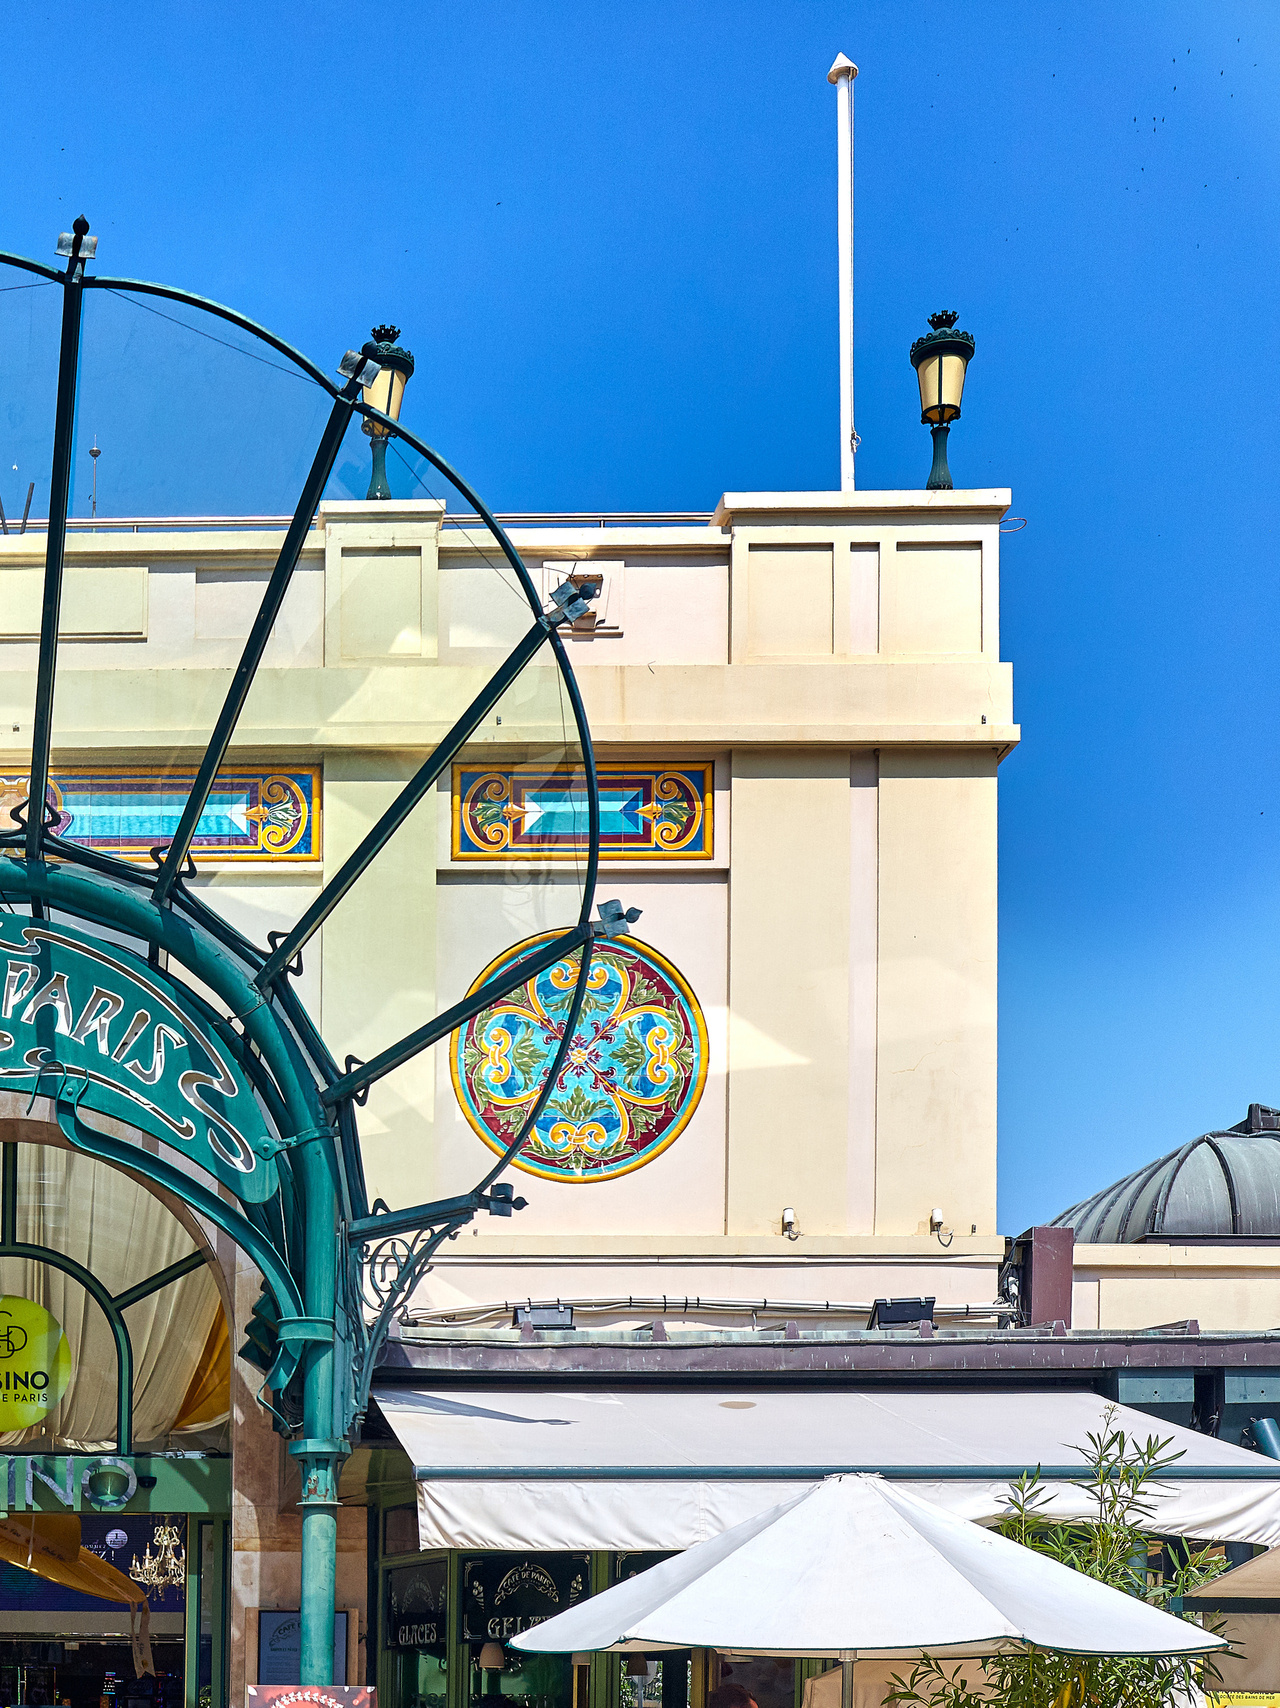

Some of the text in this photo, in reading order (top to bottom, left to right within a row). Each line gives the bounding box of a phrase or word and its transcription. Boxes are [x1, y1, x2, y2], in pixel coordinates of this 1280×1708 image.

[1, 960, 188, 1085] PARIS
[14, 1393, 48, 1402] PARIS
[521, 1571, 530, 1579] DE
[531, 1571, 551, 1588] PARIS
[398, 1622, 437, 1646] GLACES
